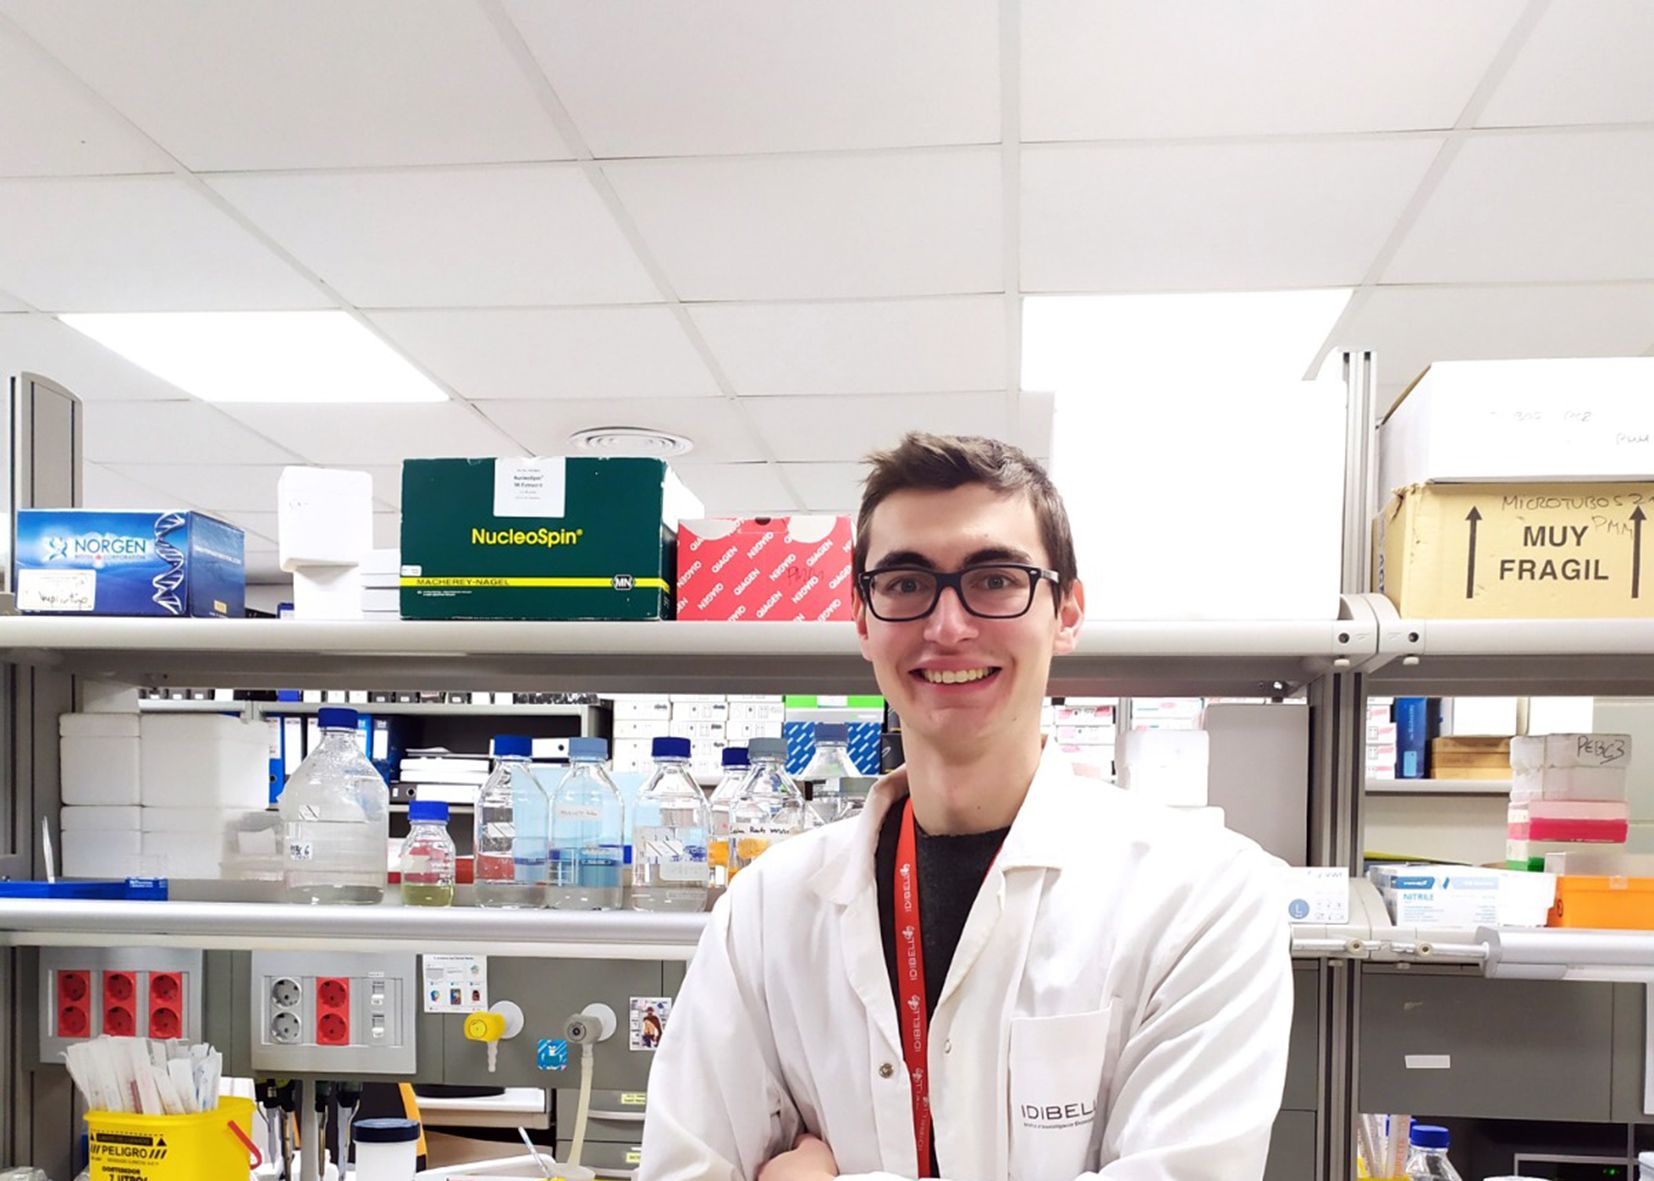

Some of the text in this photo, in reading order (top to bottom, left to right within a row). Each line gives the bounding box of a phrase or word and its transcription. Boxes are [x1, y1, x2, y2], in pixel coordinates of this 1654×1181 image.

[75, 538, 146, 553] NORGEN
[747, 531, 774, 559] QIAGEN
[1523, 525, 1589, 547] MUY
[712, 546, 738, 573] QIAGEN
[769, 553, 796, 581] QIAGEN
[806, 539, 833, 567] QIAGEN
[417, 578, 509, 586] MACHEREY-NAGEL
[733, 568, 761, 596] QIAGEN
[829, 564, 852, 589] QIAGE
[1499, 559, 1609, 580] FRAGIL
[697, 583, 724, 610] QIAGEN
[756, 590, 782, 618] QIAGEN
[792, 576, 819, 604] QIAGEN
[902, 872, 912, 912] IDIBELL
[907, 937, 918, 981] IDIBELL
[913, 1010, 922, 1052] IDIBELL
[101, 1145, 148, 1159] PELIGRO
